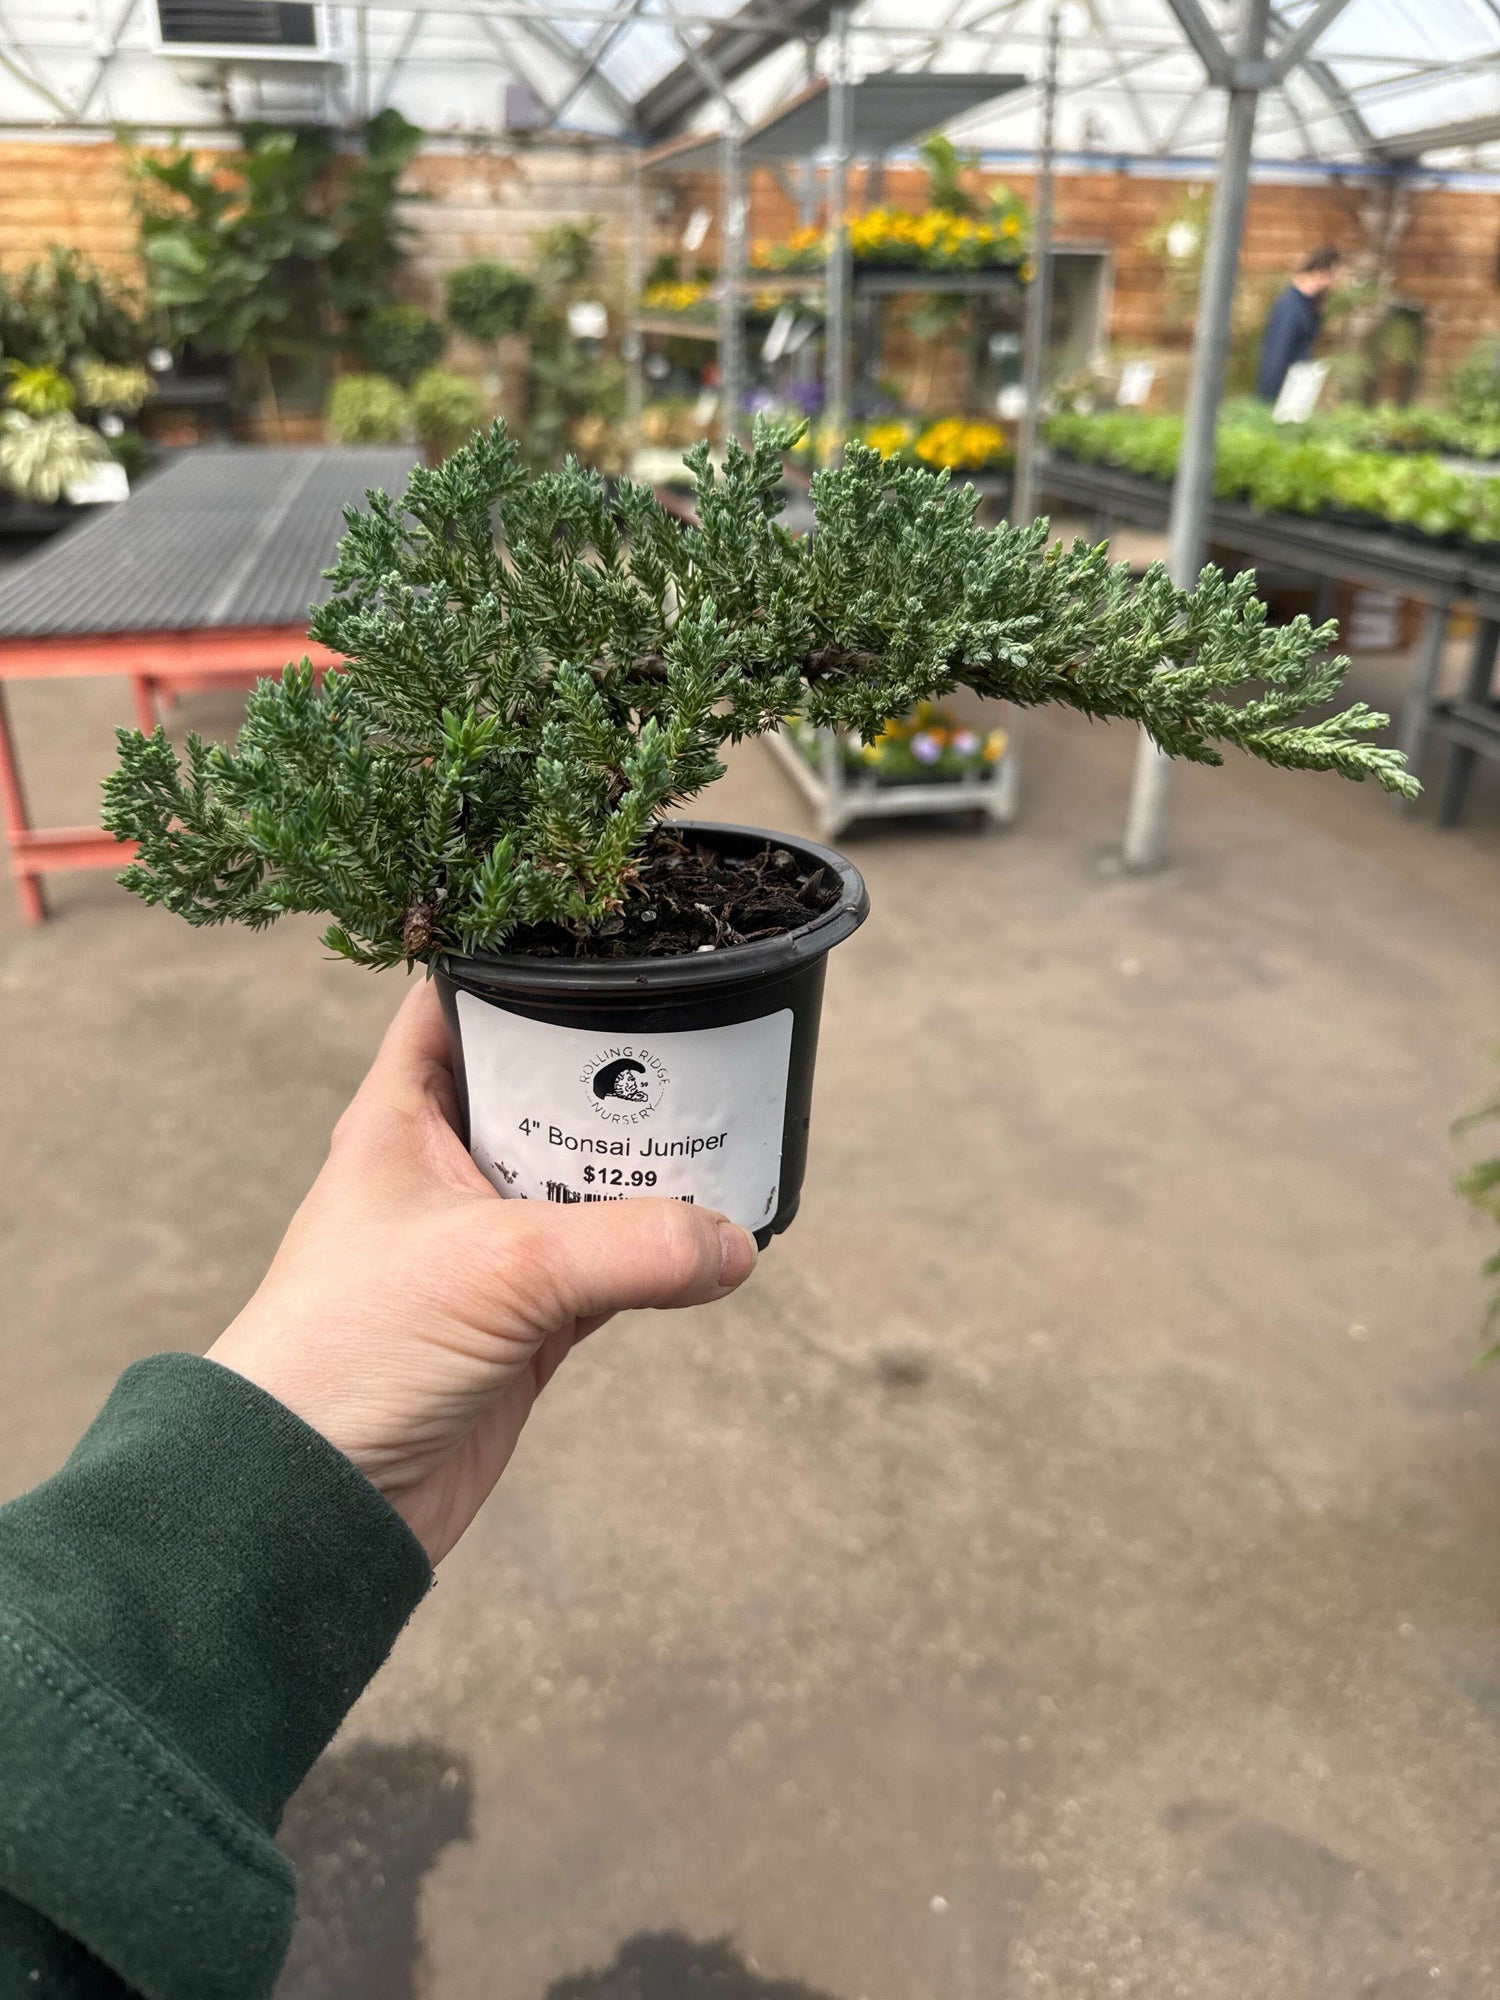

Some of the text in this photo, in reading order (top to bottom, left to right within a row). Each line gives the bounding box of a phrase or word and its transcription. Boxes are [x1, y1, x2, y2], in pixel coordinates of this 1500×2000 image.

[579, 1046, 633, 1084] ROLLING
[591, 1103, 656, 1125] NURSERY
[518, 1118, 728, 1158] 4" Bonsai Juniper
[583, 1165, 658, 1187] $12.99
